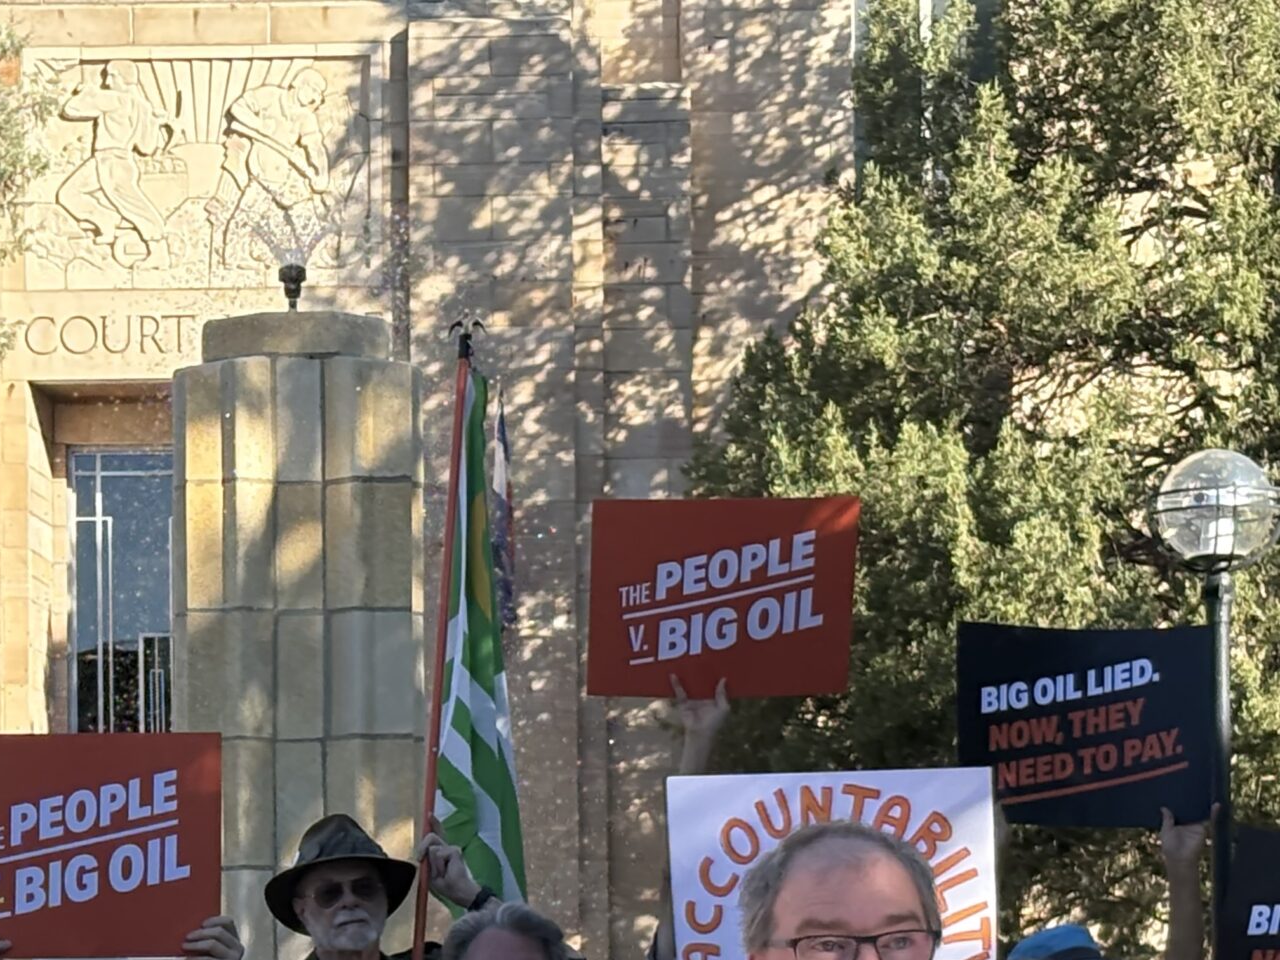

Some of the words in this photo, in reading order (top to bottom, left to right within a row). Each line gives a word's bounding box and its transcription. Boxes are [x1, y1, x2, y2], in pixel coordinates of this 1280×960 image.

[25, 315, 195, 355] COURT
[619, 583, 651, 608] THE
[655, 530, 816, 601] PEOPLE
[629, 624, 648, 653] V.
[657, 607, 738, 661] BIG
[746, 588, 824, 641] OIL
[980, 681, 1029, 714] BIG
[1033, 673, 1082, 705] OIL
[1086, 658, 1160, 697] LIED.
[988, 716, 1064, 751] NOW,
[1068, 698, 1146, 739] THEY
[997, 752, 1074, 790] NEED
[1077, 743, 1118, 775] TO
[1123, 728, 1184, 766] PAY.
[10, 769, 178, 847] PEOPLE
[15, 853, 99, 916] BIG
[108, 834, 191, 893] OIL
